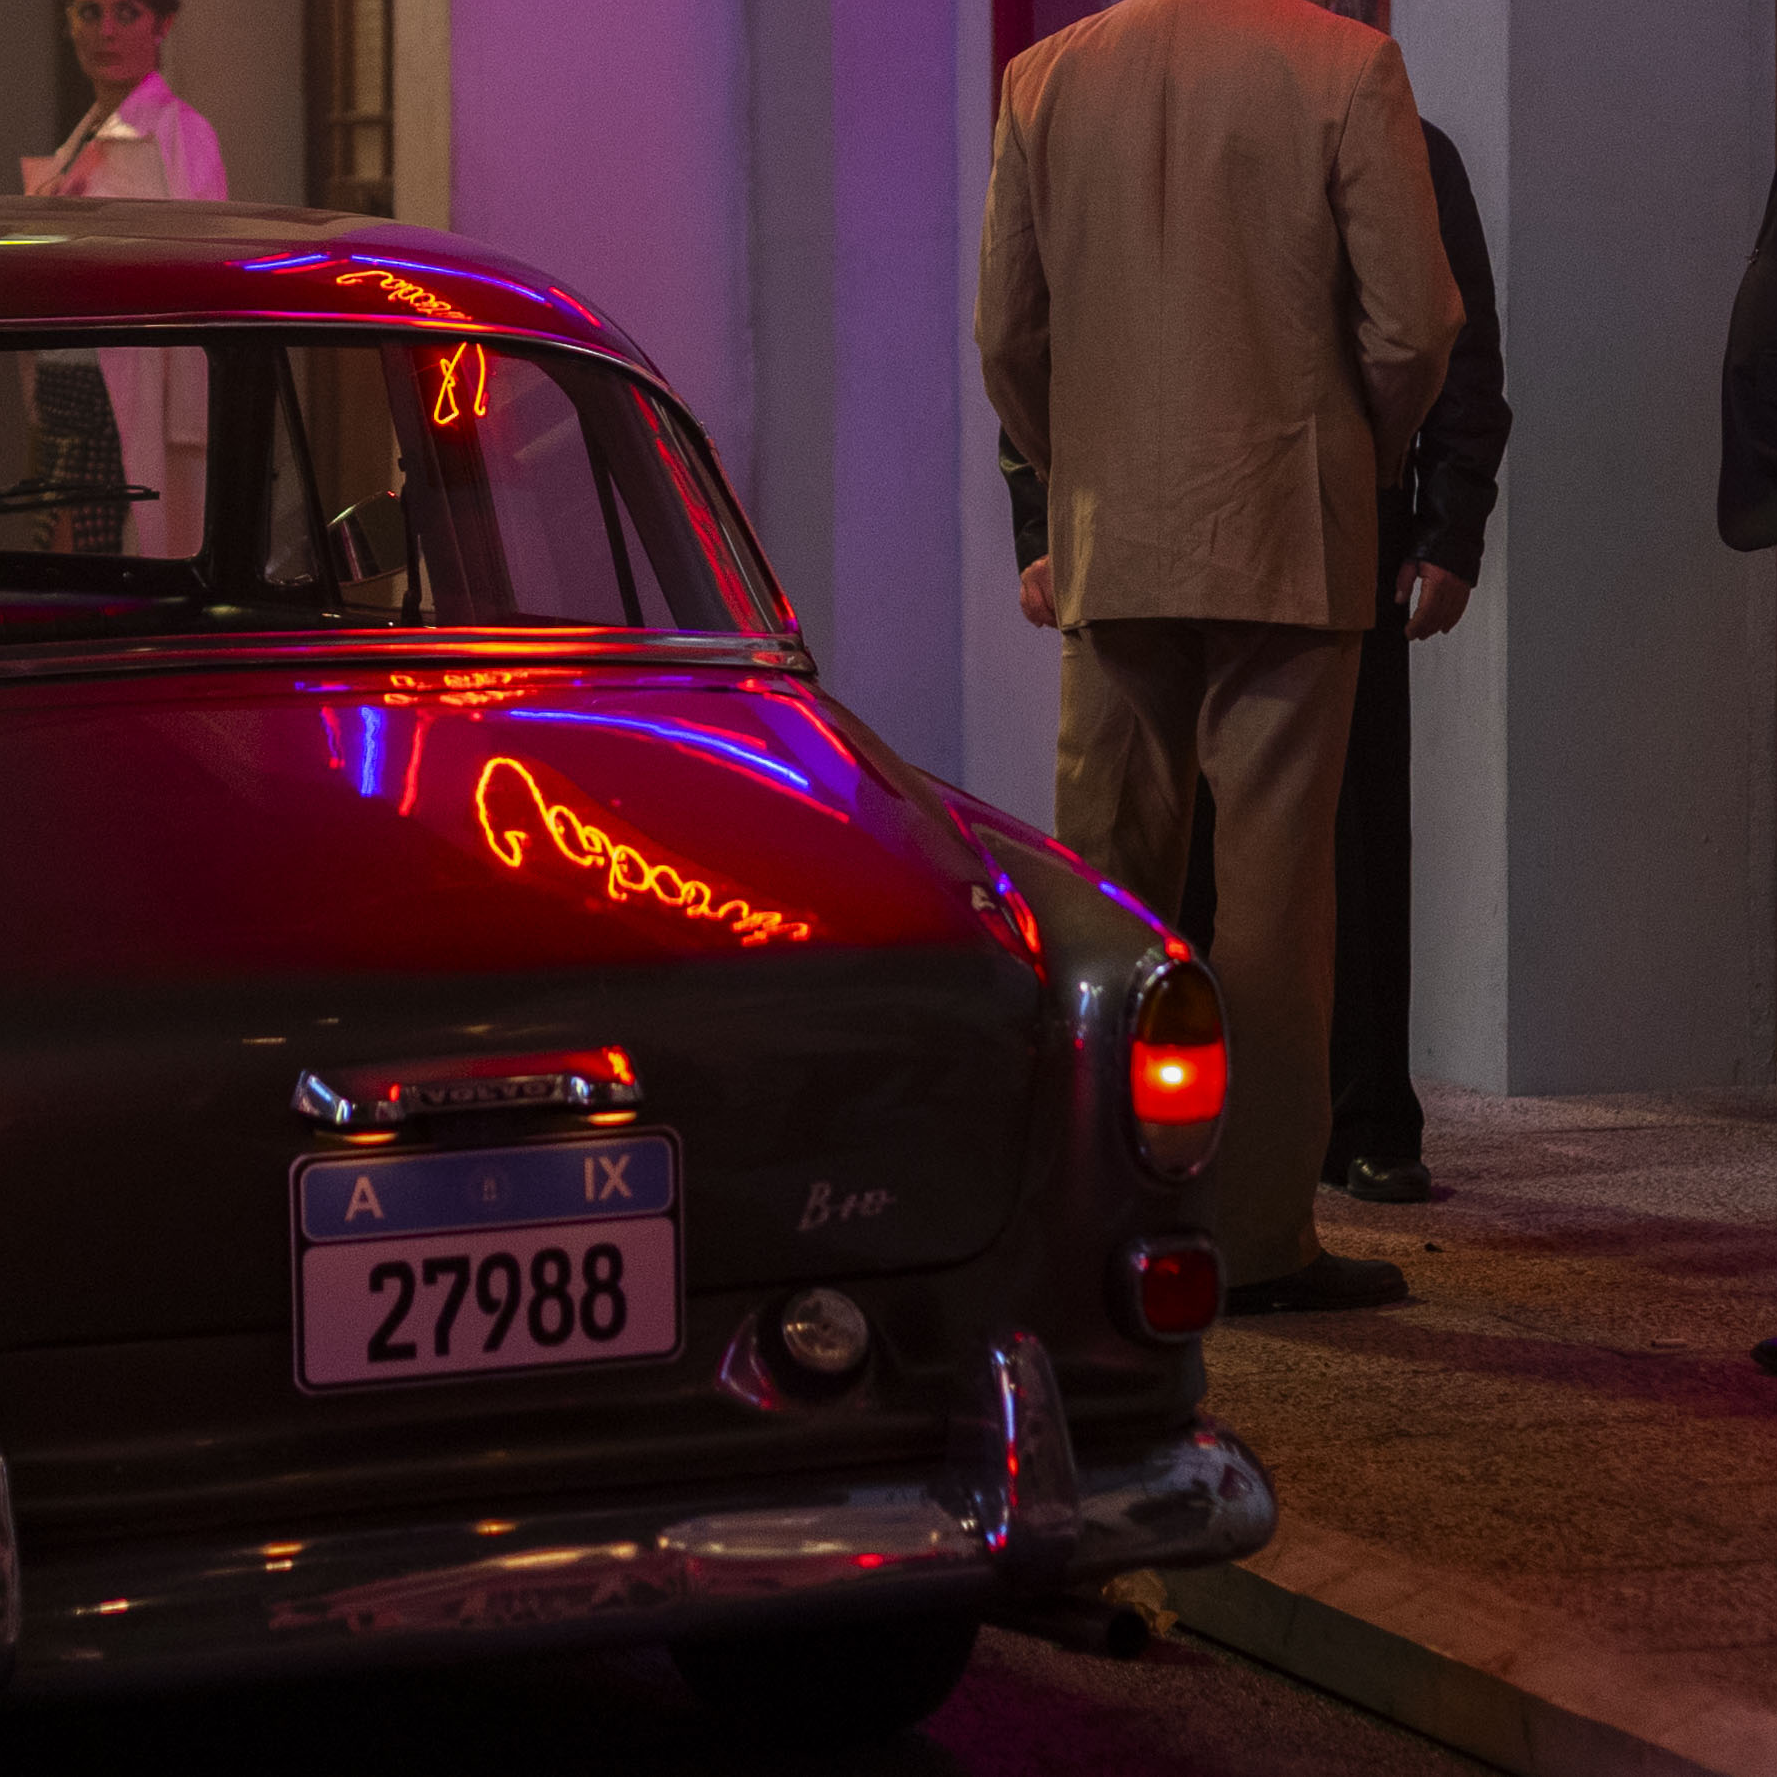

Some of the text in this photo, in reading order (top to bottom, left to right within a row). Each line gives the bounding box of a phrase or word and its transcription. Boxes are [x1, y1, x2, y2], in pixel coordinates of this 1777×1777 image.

[423, 1080, 551, 1105] VOLVO
[344, 1153, 633, 1222] A IX
[365, 1242, 628, 1366] 27988
